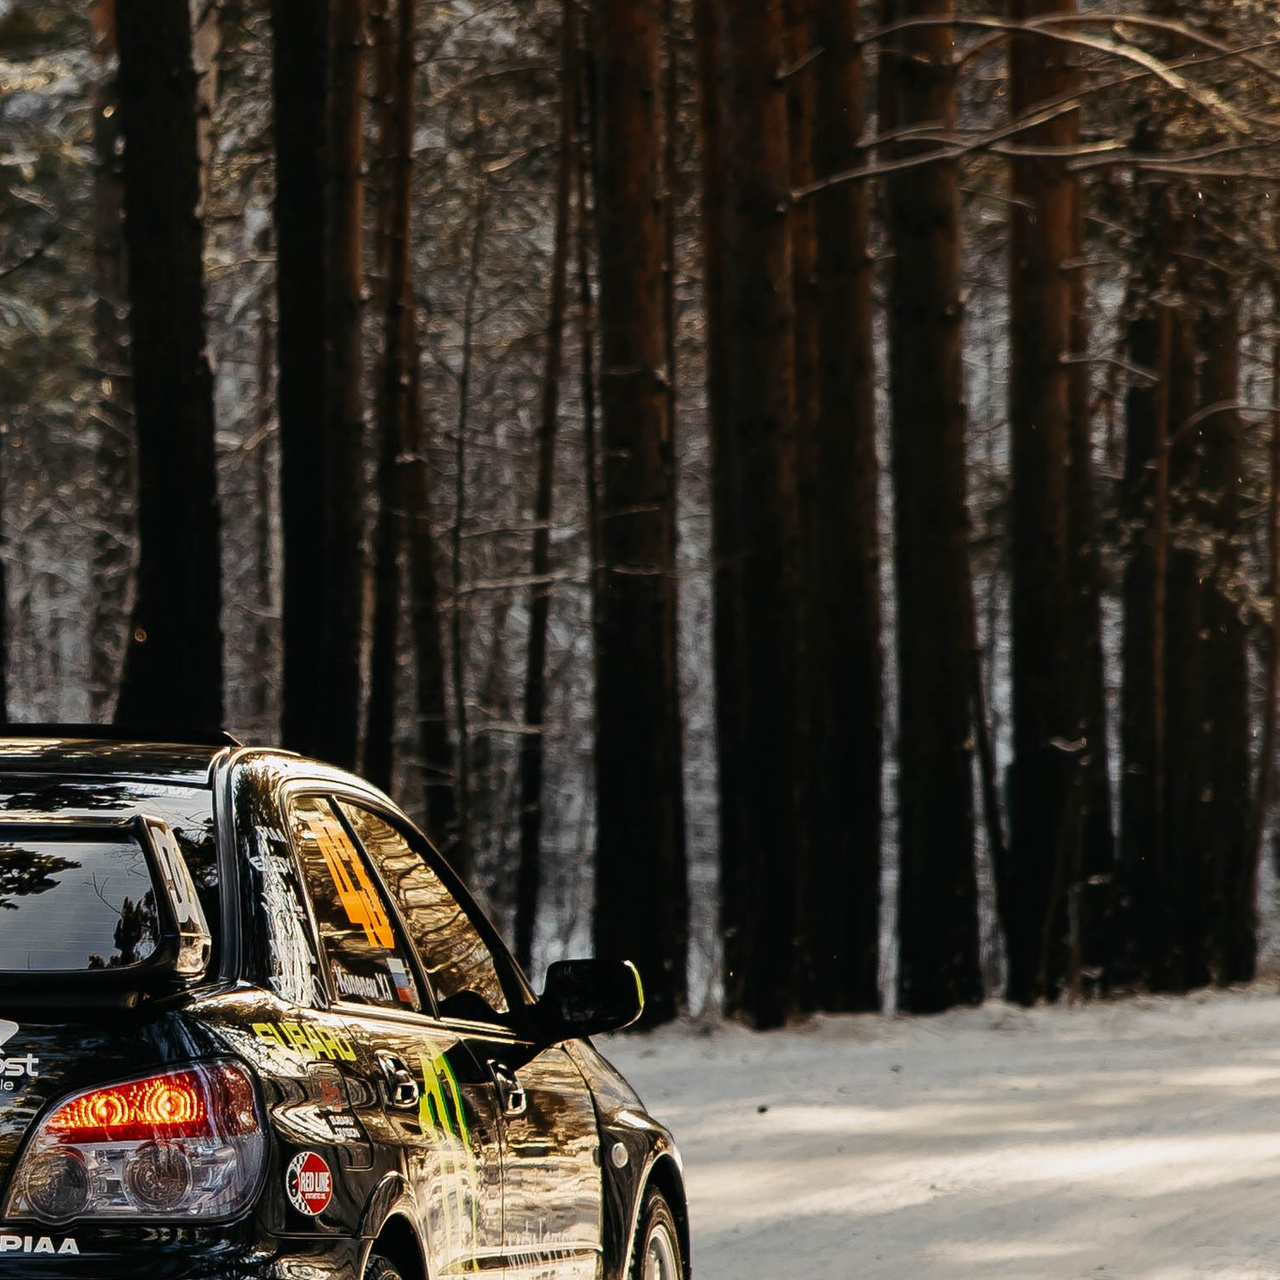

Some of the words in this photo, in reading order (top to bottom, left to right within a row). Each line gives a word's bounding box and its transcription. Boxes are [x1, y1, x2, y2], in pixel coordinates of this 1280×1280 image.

[252, 1022, 356, 1061] SUBARU
[300, 1171, 314, 1192] RED
[315, 1171, 330, 1192] LINE
[0, 1235, 80, 1255] PIAA
